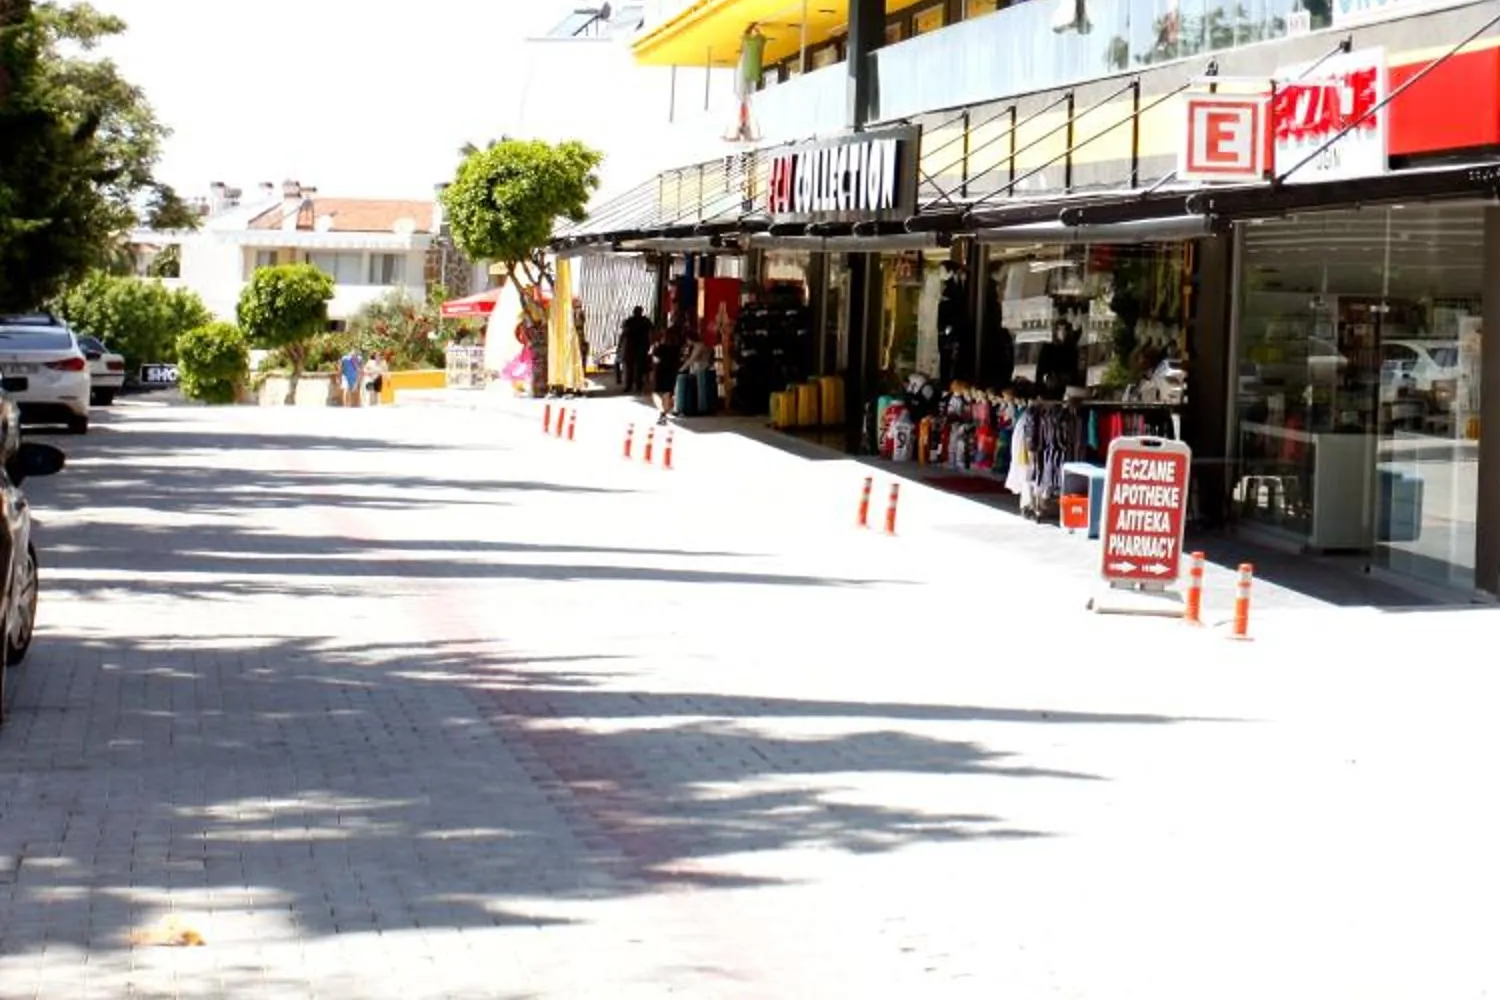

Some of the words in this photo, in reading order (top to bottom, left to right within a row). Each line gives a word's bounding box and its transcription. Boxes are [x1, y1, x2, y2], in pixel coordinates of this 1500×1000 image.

[1205, 112, 1240, 162] E
[794, 138, 897, 214] COLLECTION
[148, 367, 179, 381] SHO
[1120, 458, 1177, 483] ECZANE
[1113, 484, 1180, 507] APOTHEKE
[1115, 509, 1171, 533] АПТЕКА
[1108, 534, 1175, 558] PHARMACY
